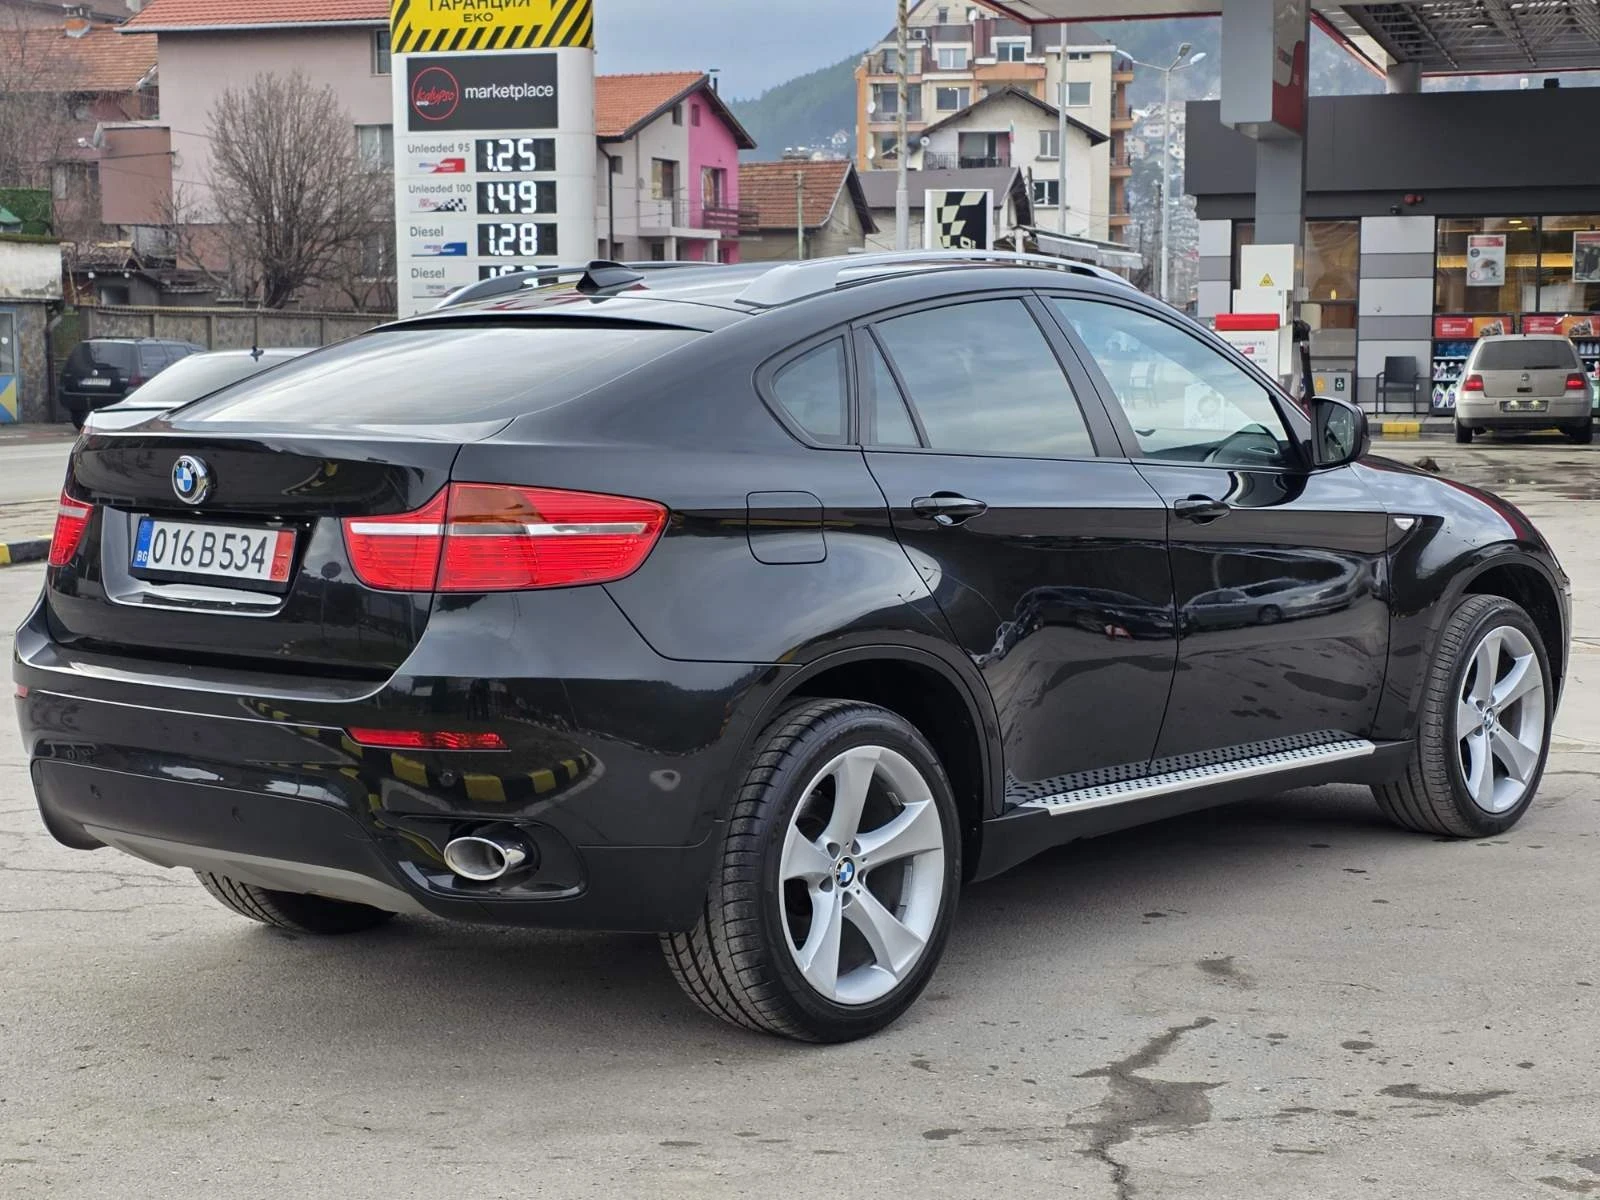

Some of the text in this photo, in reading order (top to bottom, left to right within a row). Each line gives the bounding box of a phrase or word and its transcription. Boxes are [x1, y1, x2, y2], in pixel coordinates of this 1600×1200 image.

[429, 0, 531, 12] ГАРАНЦИЯ
[464, 83, 555, 101] marketplace
[407, 143, 471, 154] Unleaded 95
[487, 138, 537, 172] 1.25
[408, 183, 472, 194] Unleaded 100
[487, 180, 538, 214] 1.49
[410, 225, 444, 238] Diesel
[488, 222, 538, 256] 1.28
[411, 267, 445, 279] Diesel
[136, 527, 268, 574] BG 016B534
